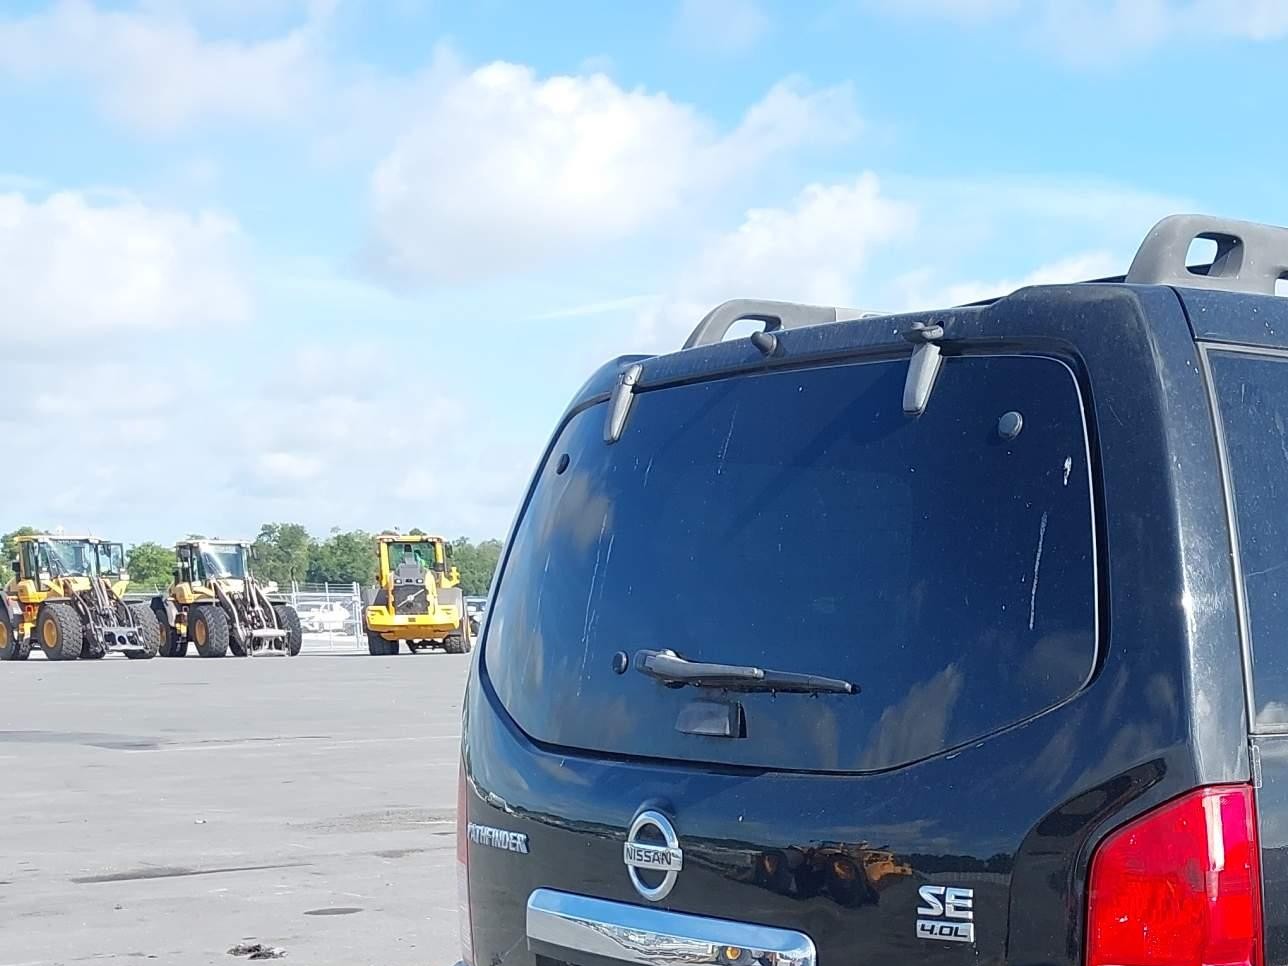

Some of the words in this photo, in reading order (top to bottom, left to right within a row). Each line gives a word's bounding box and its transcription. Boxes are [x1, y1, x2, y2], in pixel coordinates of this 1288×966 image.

[626, 846, 672, 866] NISSAN
[917, 885, 974, 920] SE
[920, 923, 969, 938] 4.0L
